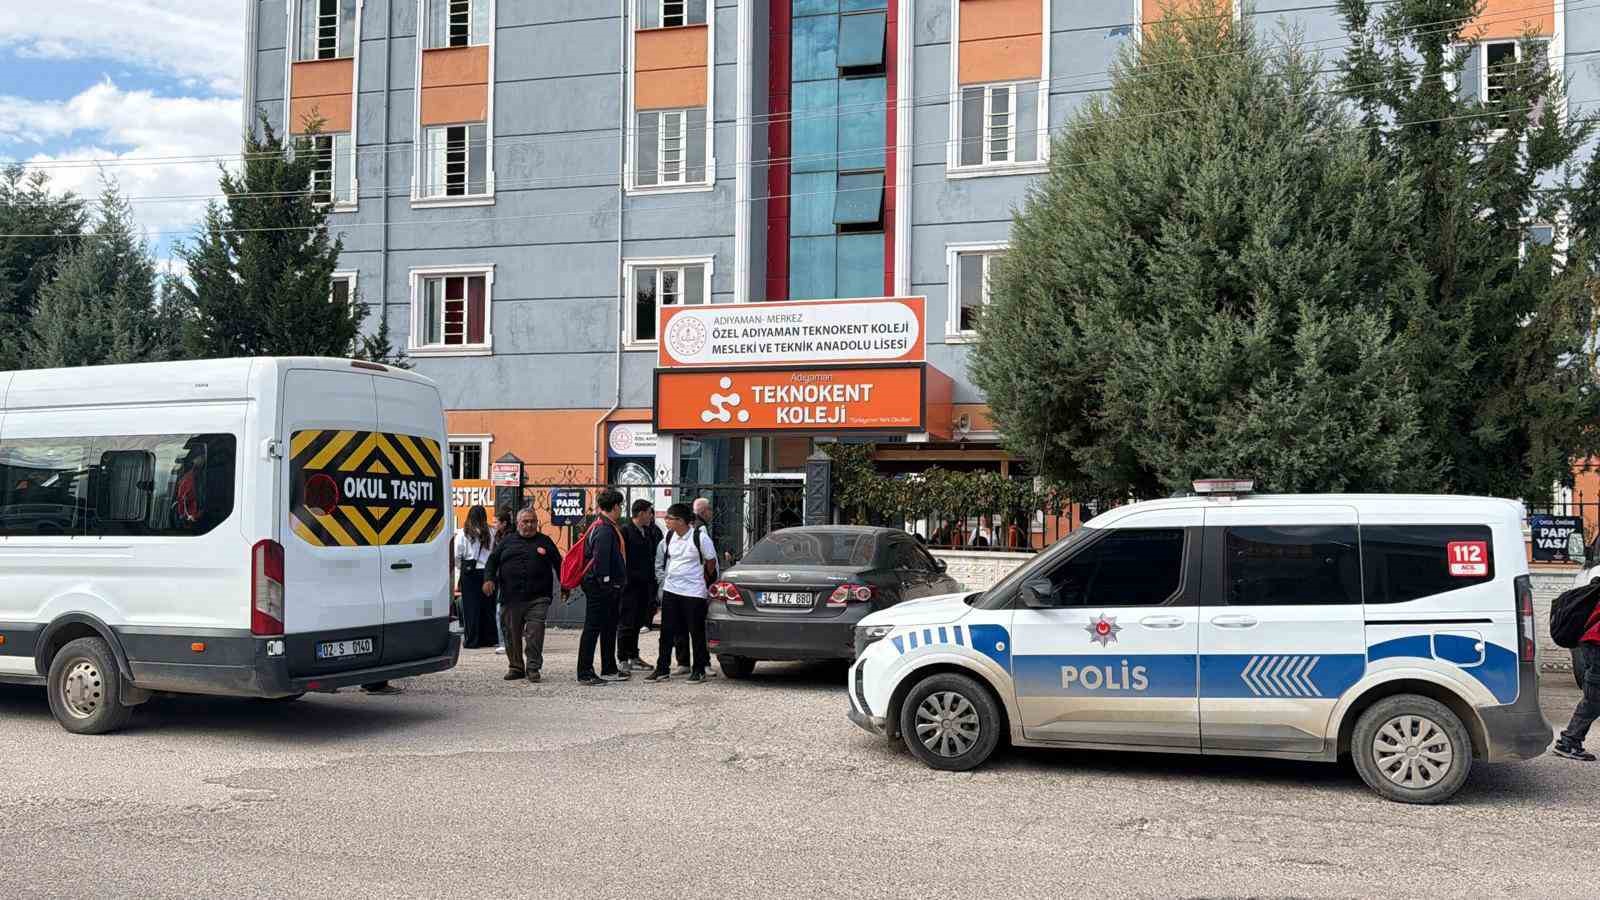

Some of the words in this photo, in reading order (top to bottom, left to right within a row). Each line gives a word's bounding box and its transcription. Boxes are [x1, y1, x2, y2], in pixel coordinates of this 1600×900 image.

[766, 313, 803, 324] MERKEZ
[712, 328, 739, 339] ÖZEL
[742, 326, 800, 338] ADIYAMAN
[803, 324, 869, 337] TEKNOKENT
[872, 322, 909, 334] KOLEJİ
[759, 343, 772, 353] VE
[774, 340, 814, 352] TEKNİK
[816, 339, 871, 352] ANADOLU
[874, 337, 908, 350] LİSESİ
[752, 383, 874, 404] TEKNOKENT
[776, 404, 847, 424] KOLEJİ
[343, 476, 388, 500] OKUL
[390, 479, 433, 506] TAŞITI
[556, 498, 580, 507] PARK
[553, 507, 583, 516] YASAK
[1454, 545, 1482, 562] 112
[323, 643, 334, 656] 02
[339, 642, 345, 655] S
[1060, 659, 1149, 690] POLİS
